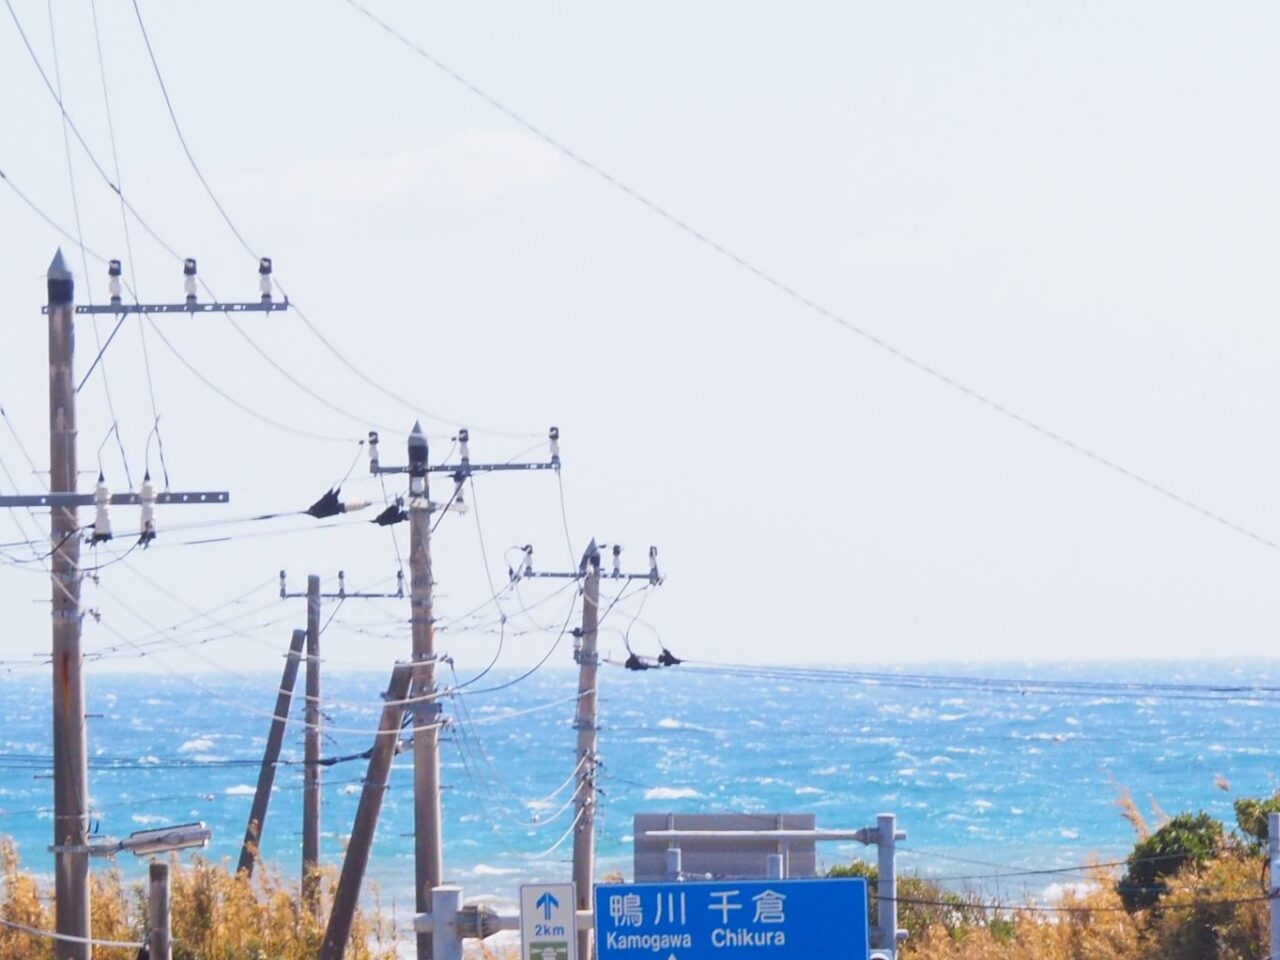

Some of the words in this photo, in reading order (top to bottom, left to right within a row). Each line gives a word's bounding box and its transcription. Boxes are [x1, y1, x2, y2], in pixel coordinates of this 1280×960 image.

[609, 892, 686, 927] 鴨川
[708, 889, 786, 923] 千倉
[535, 924, 564, 936] 2km
[606, 931, 692, 952] Kamogawa
[711, 928, 785, 947] Chikura
